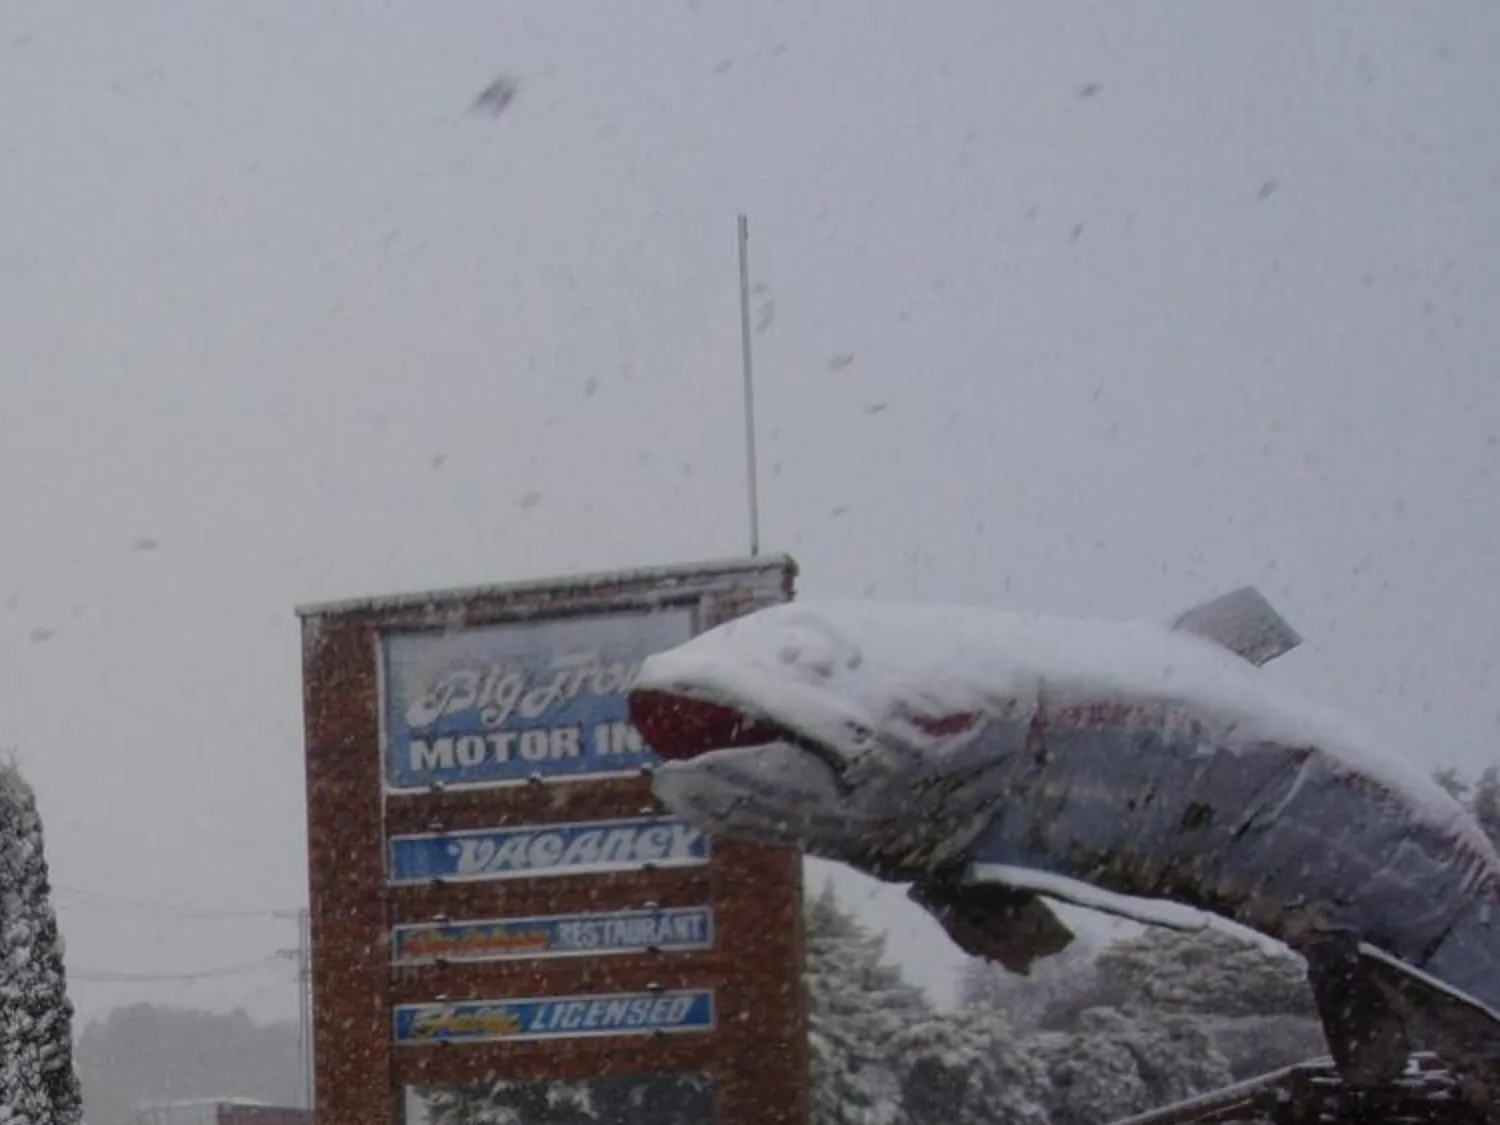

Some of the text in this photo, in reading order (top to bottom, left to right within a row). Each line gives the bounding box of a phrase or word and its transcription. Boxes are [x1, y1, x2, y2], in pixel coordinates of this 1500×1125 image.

[406, 652, 640, 728] Big Tro
[409, 719, 653, 771] MOTOR IN
[448, 823, 701, 872] VACANCY
[557, 914, 702, 950] RESTAURANT
[529, 995, 695, 1031] LICENSED
